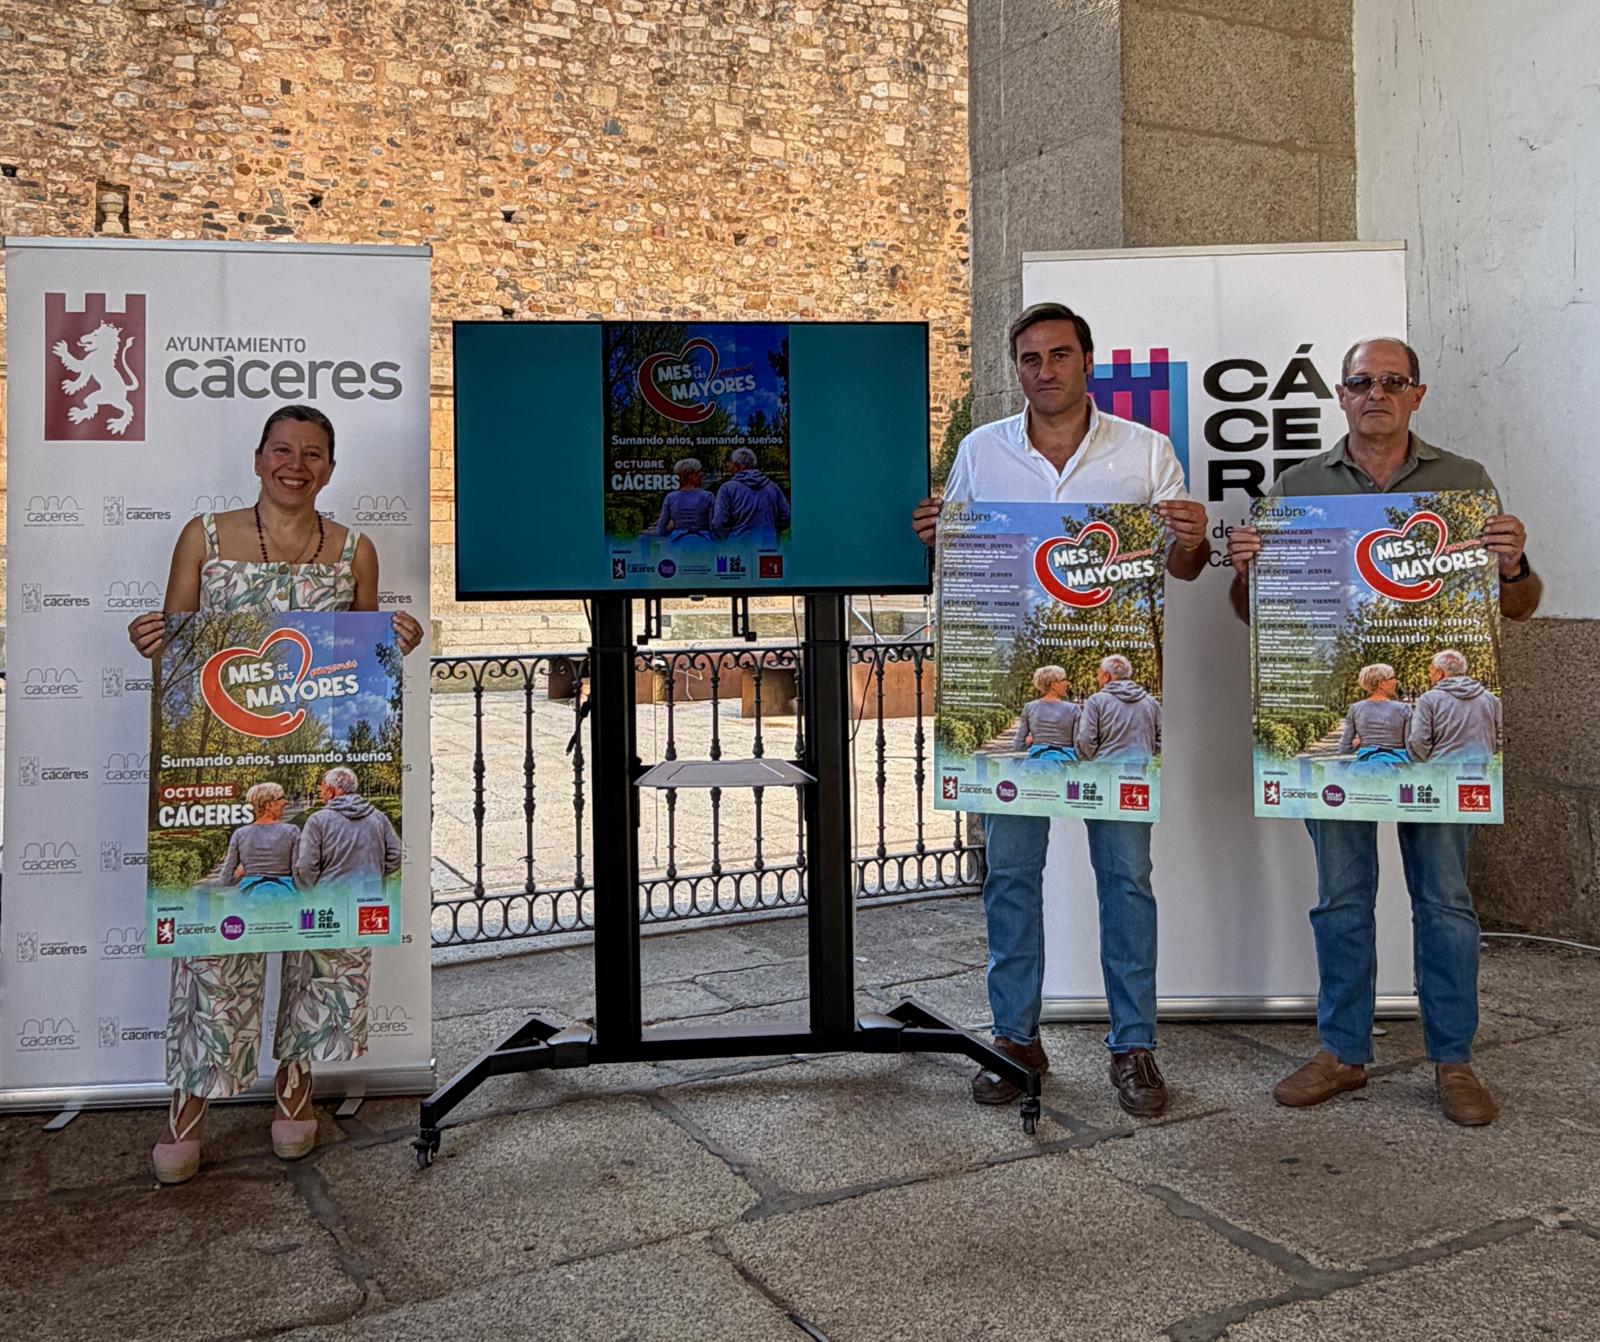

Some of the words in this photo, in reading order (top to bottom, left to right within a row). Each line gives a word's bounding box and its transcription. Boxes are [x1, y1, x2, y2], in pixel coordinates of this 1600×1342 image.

[165, 337, 306, 353] AYUNTAMIENTO
[657, 364, 692, 382] MES
[1203, 343, 1334, 402] CÁ
[671, 374, 756, 402] MAYORES
[1204, 407, 1322, 452] CE
[611, 434, 664, 446] Sumando
[696, 435, 745, 446] sumando
[614, 459, 665, 469] OCTUBRE
[611, 472, 681, 491] CÁCERES
[1255, 506, 1306, 518] Octubre
[1053, 548, 1088, 568] MES
[1376, 540, 1415, 561] MES
[1066, 560, 1155, 587] MAYORES
[1391, 548, 1488, 581] MAYORES
[228, 662, 275, 685] MES
[278, 672, 295, 680] LAS
[246, 674, 360, 709] MAYORES
[161, 754, 233, 768] Sumando
[236, 753, 274, 767] años,
[278, 752, 343, 764] sumando
[346, 750, 392, 763] sueños
[164, 786, 234, 800] OCTUBRE
[158, 802, 254, 828] CÁCERES
